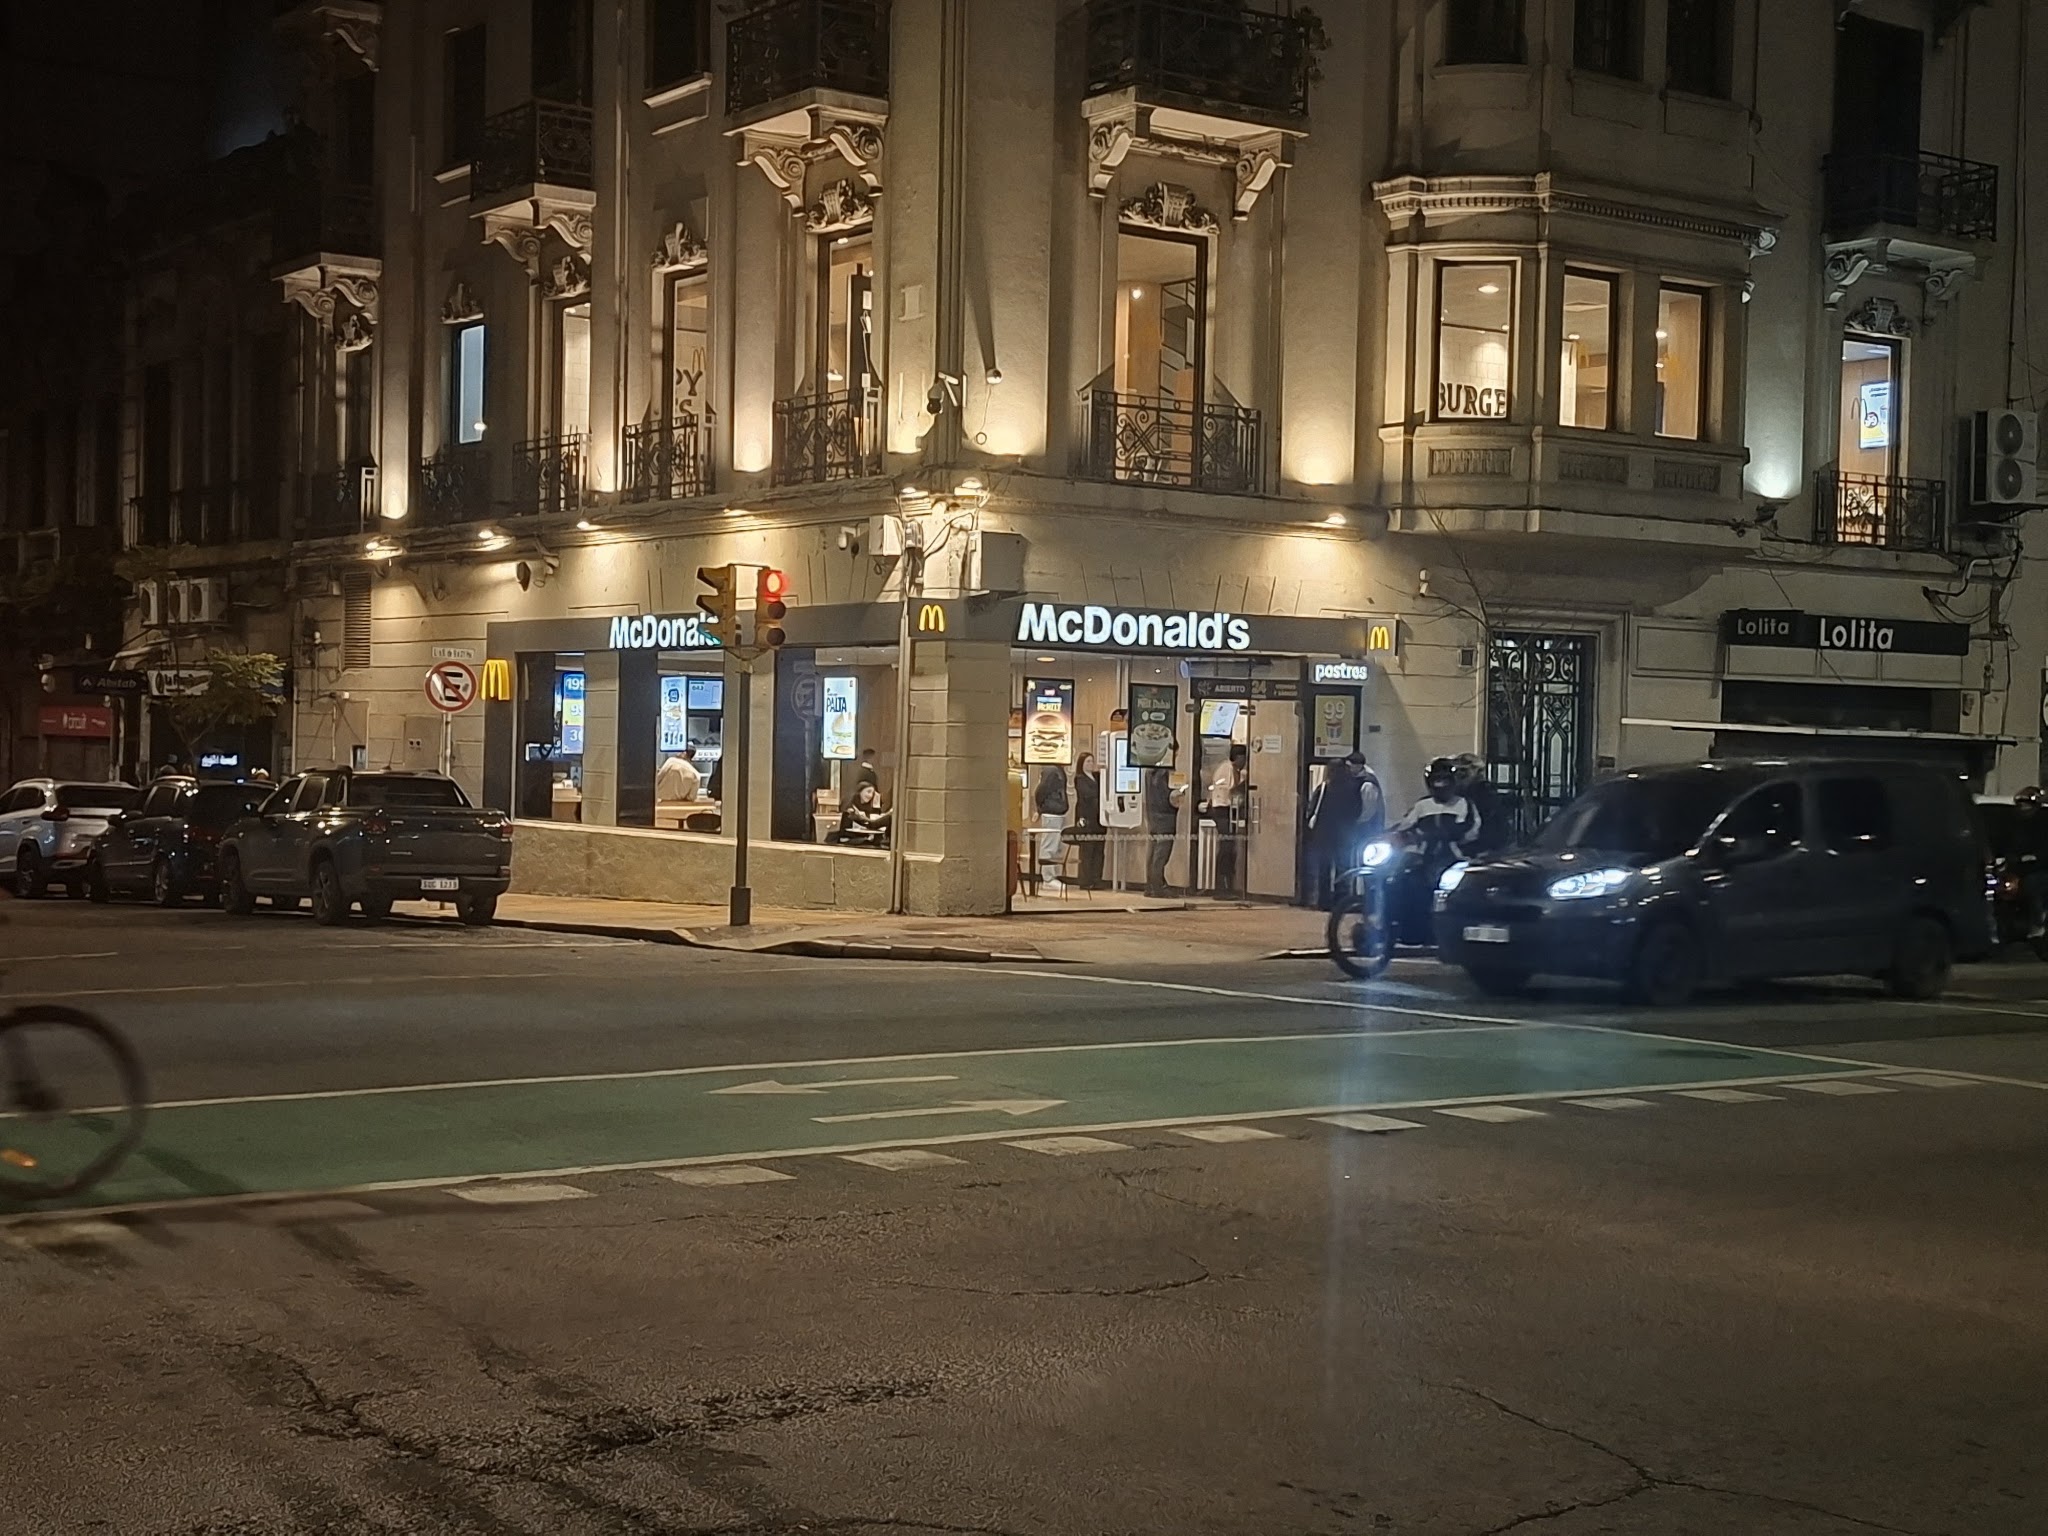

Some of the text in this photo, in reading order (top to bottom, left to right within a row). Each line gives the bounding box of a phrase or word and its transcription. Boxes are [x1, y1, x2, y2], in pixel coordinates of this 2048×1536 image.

[1017, 603, 1251, 650] McDonald's
[1737, 618, 1790, 635] Lolita
[1819, 618, 1894, 649] Lolita
[1315, 663, 1368, 682] postres
[1215, 685, 1246, 694] ABIERTO
[826, 697, 847, 712] PALTA
[1323, 701, 1345, 720] 99
